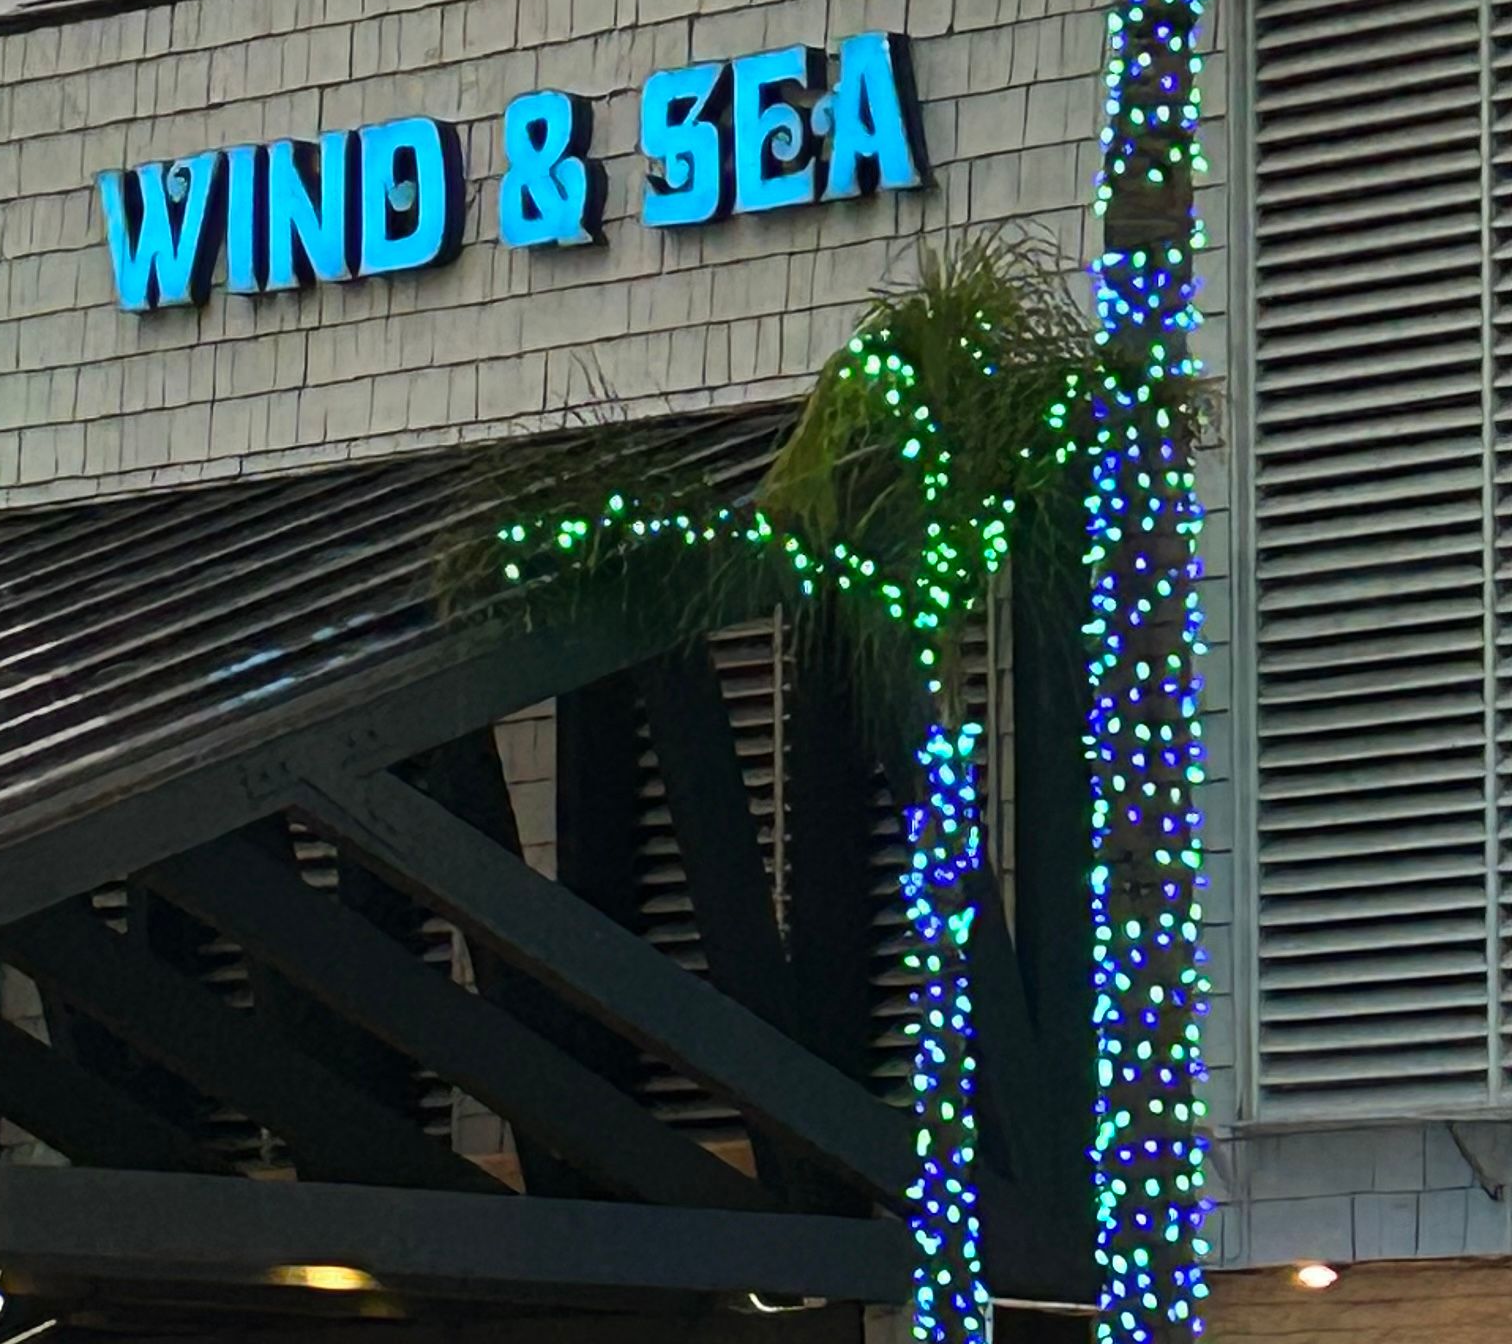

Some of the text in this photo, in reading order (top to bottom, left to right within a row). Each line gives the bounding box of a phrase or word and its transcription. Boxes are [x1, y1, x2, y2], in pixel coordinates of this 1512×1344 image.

[97, 31, 919, 312] WIND & SEA
